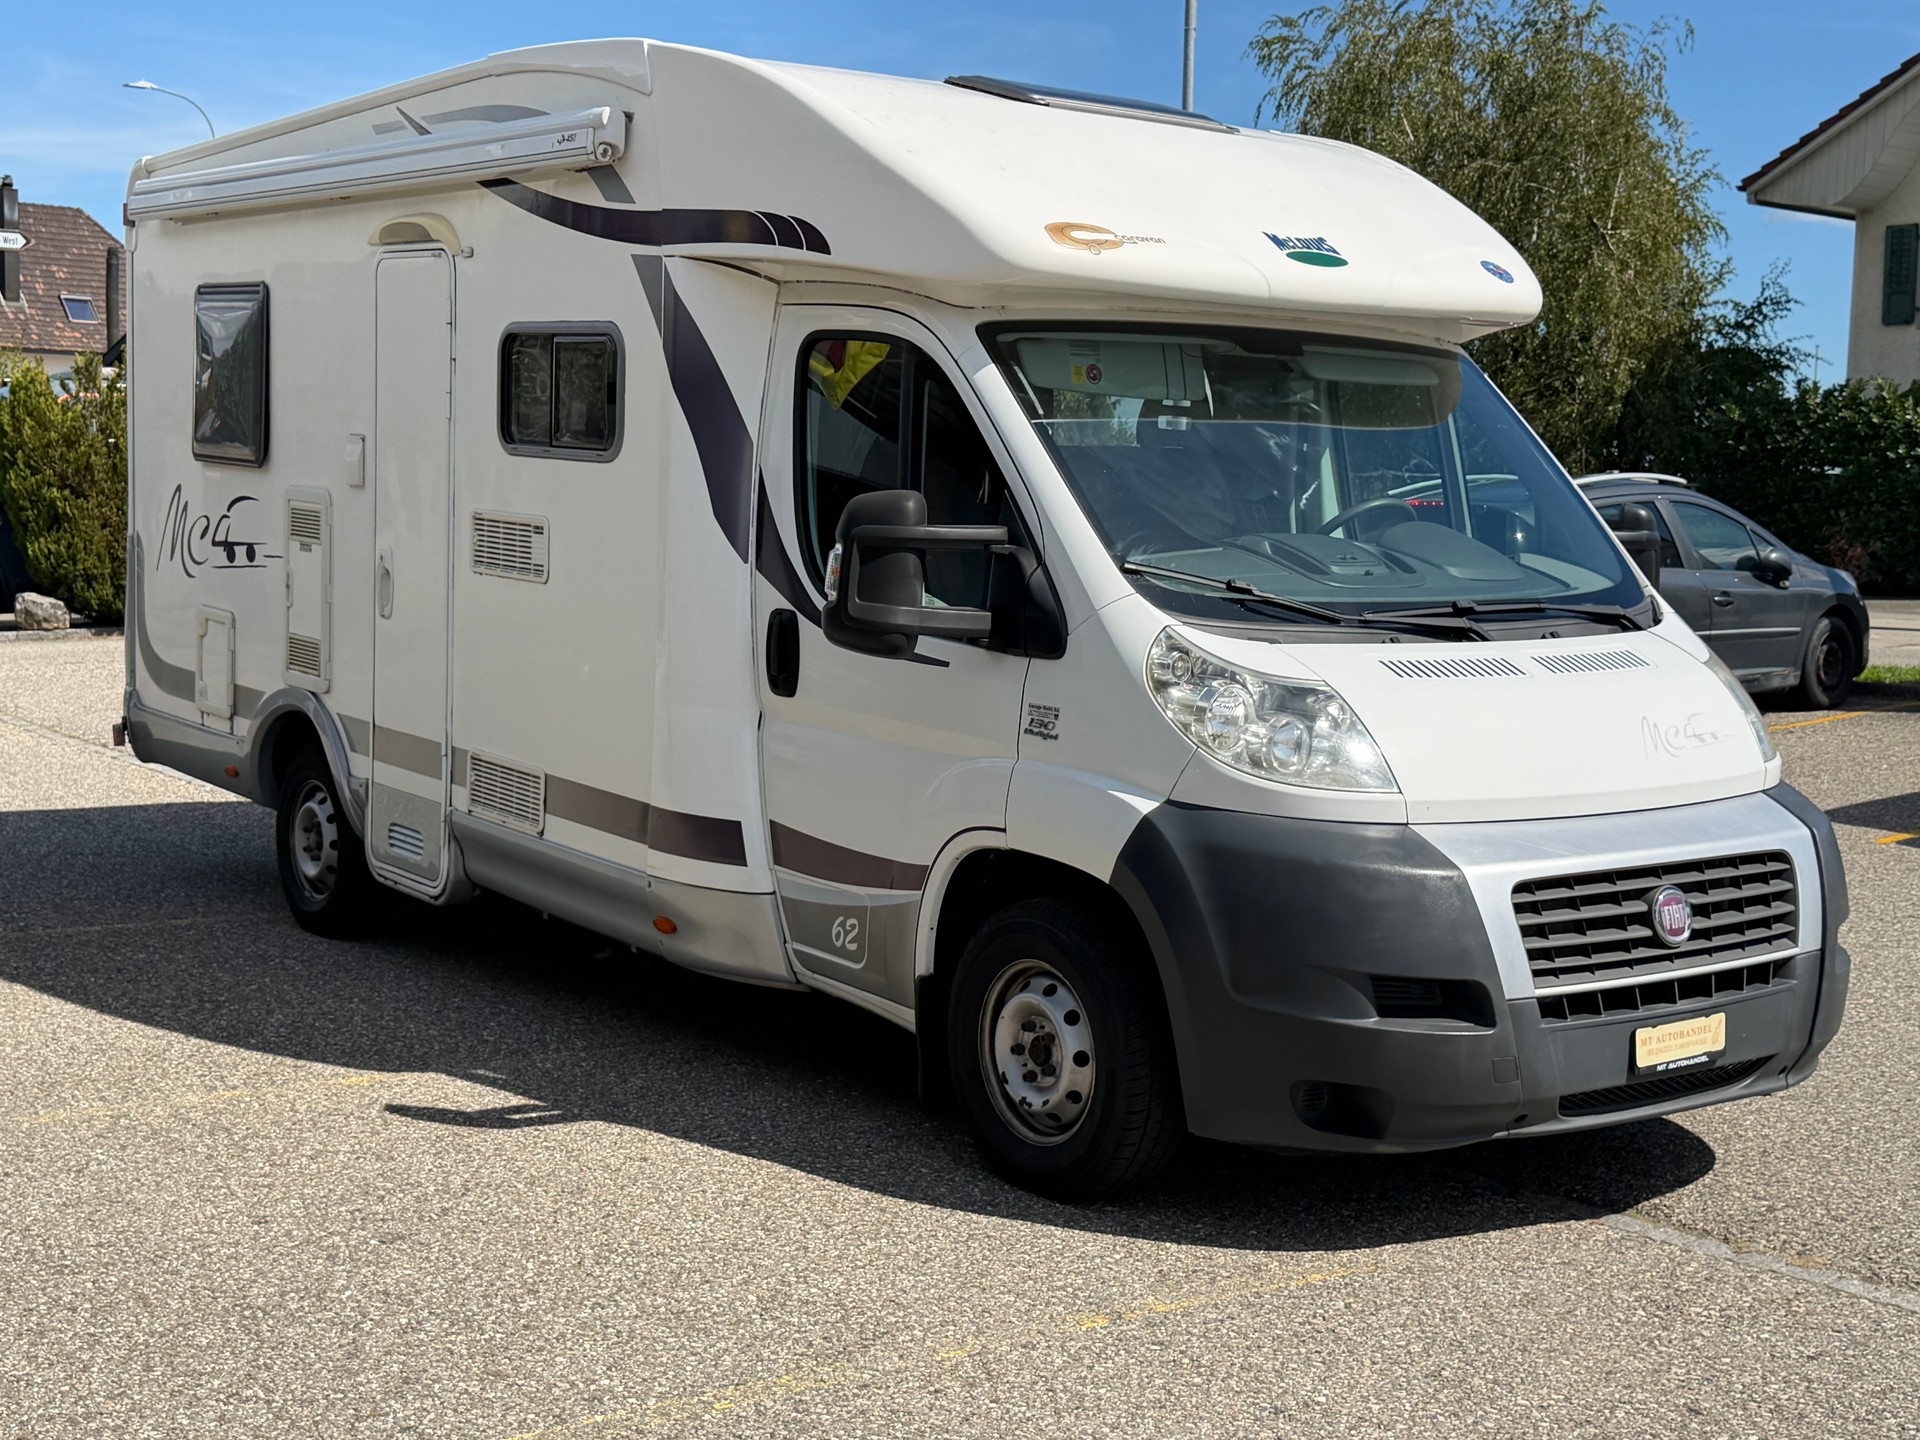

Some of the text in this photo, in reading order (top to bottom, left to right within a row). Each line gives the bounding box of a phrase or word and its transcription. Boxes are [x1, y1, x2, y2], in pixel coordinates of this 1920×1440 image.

[2, 235, 19, 246] West
[1114, 233, 1167, 244] caravan
[1664, 903, 1686, 930] FIAT
[831, 916, 859, 951] 62
[1640, 1036, 1653, 1048] MT
[1656, 1024, 1713, 1045] AUTOHANDEL
[1656, 1055, 1709, 1072] MT AUTOHANDEL
